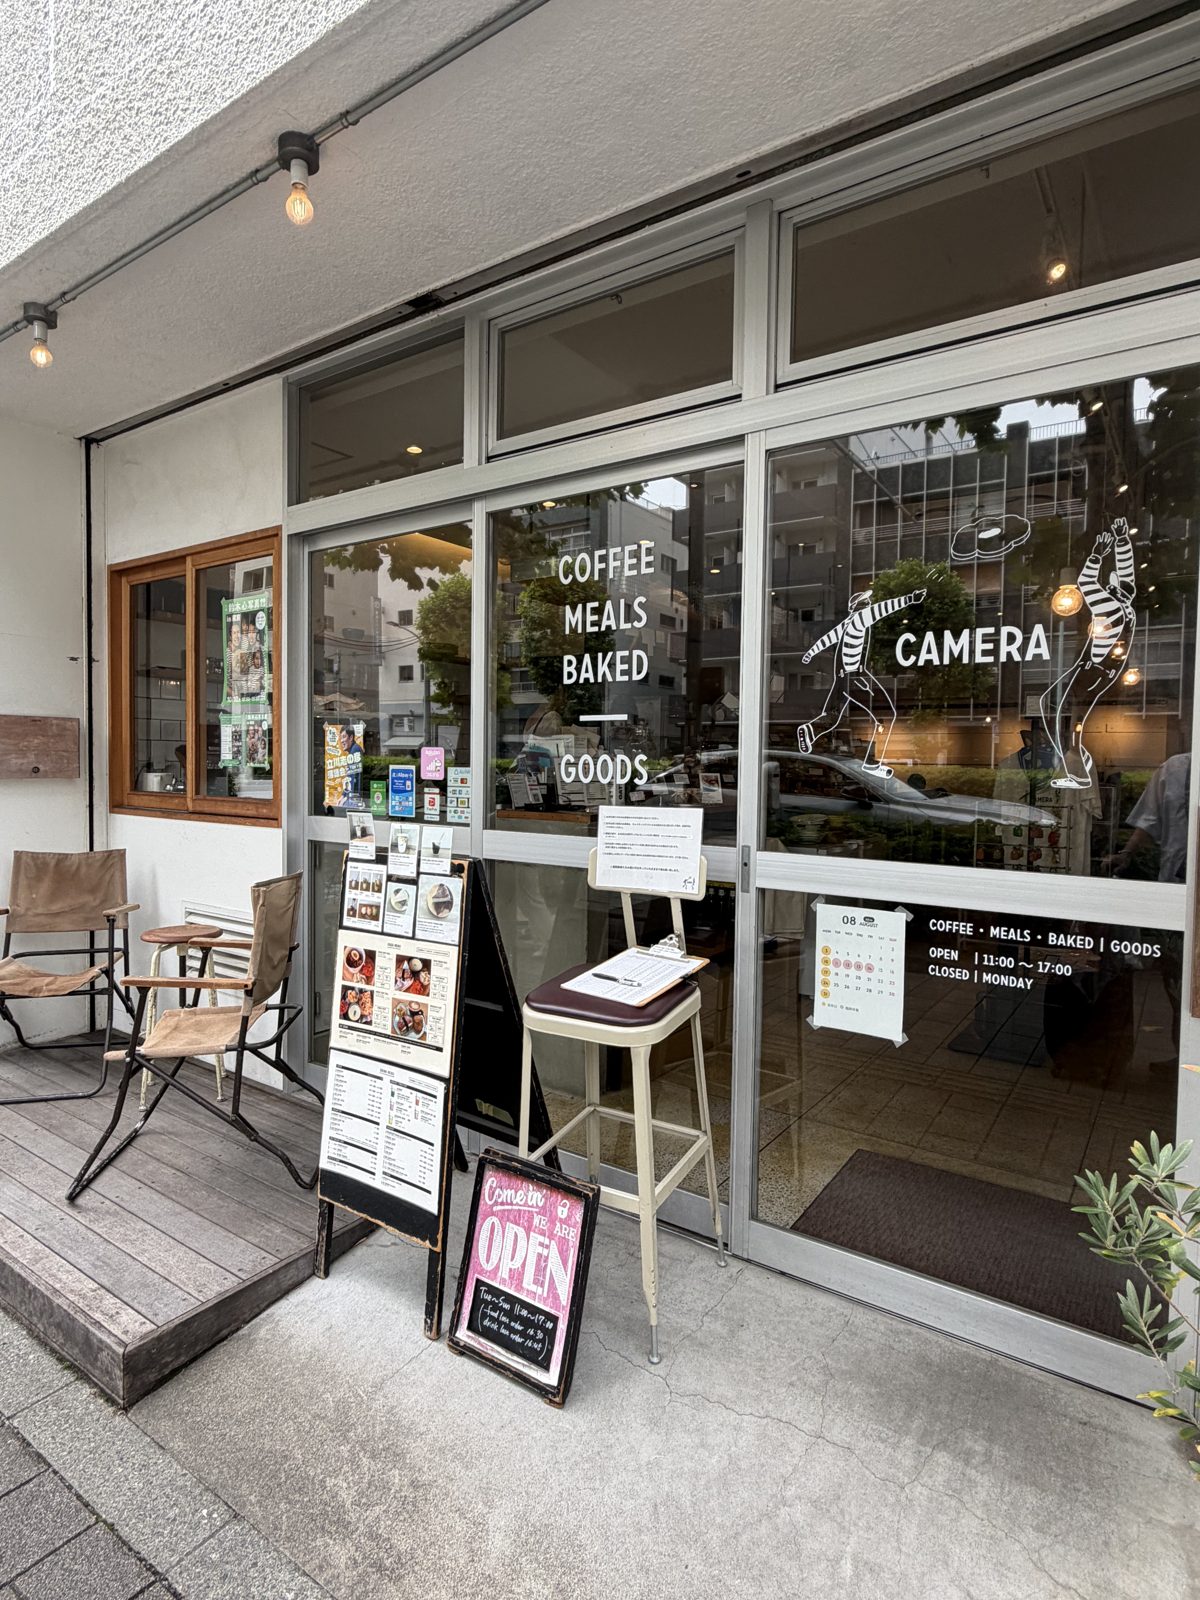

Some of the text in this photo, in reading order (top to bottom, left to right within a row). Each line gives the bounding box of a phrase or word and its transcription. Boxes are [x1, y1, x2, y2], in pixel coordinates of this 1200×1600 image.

[559, 541, 655, 585] COFFEE
[565, 596, 648, 635] MEALS
[895, 623, 1051, 667] CAMERA
[563, 649, 649, 685] BAKED
[560, 753, 648, 785] GOODS
[842, 915, 856, 926] 08
[929, 919, 1162, 958] COFFEE MEALS BAKED GOODS
[928, 965, 1034, 990] CLOSED MONDAY
[929, 947, 959, 961] OPEN
[982, 954, 1015, 969] 11:00
[1037, 961, 1072, 977] 17:00
[485, 1177, 546, 1207] Come in
[532, 1213, 576, 1241] WE ARE
[478, 1215, 574, 1306] OPEN
[527, 1328, 544, 1339] 16:30
